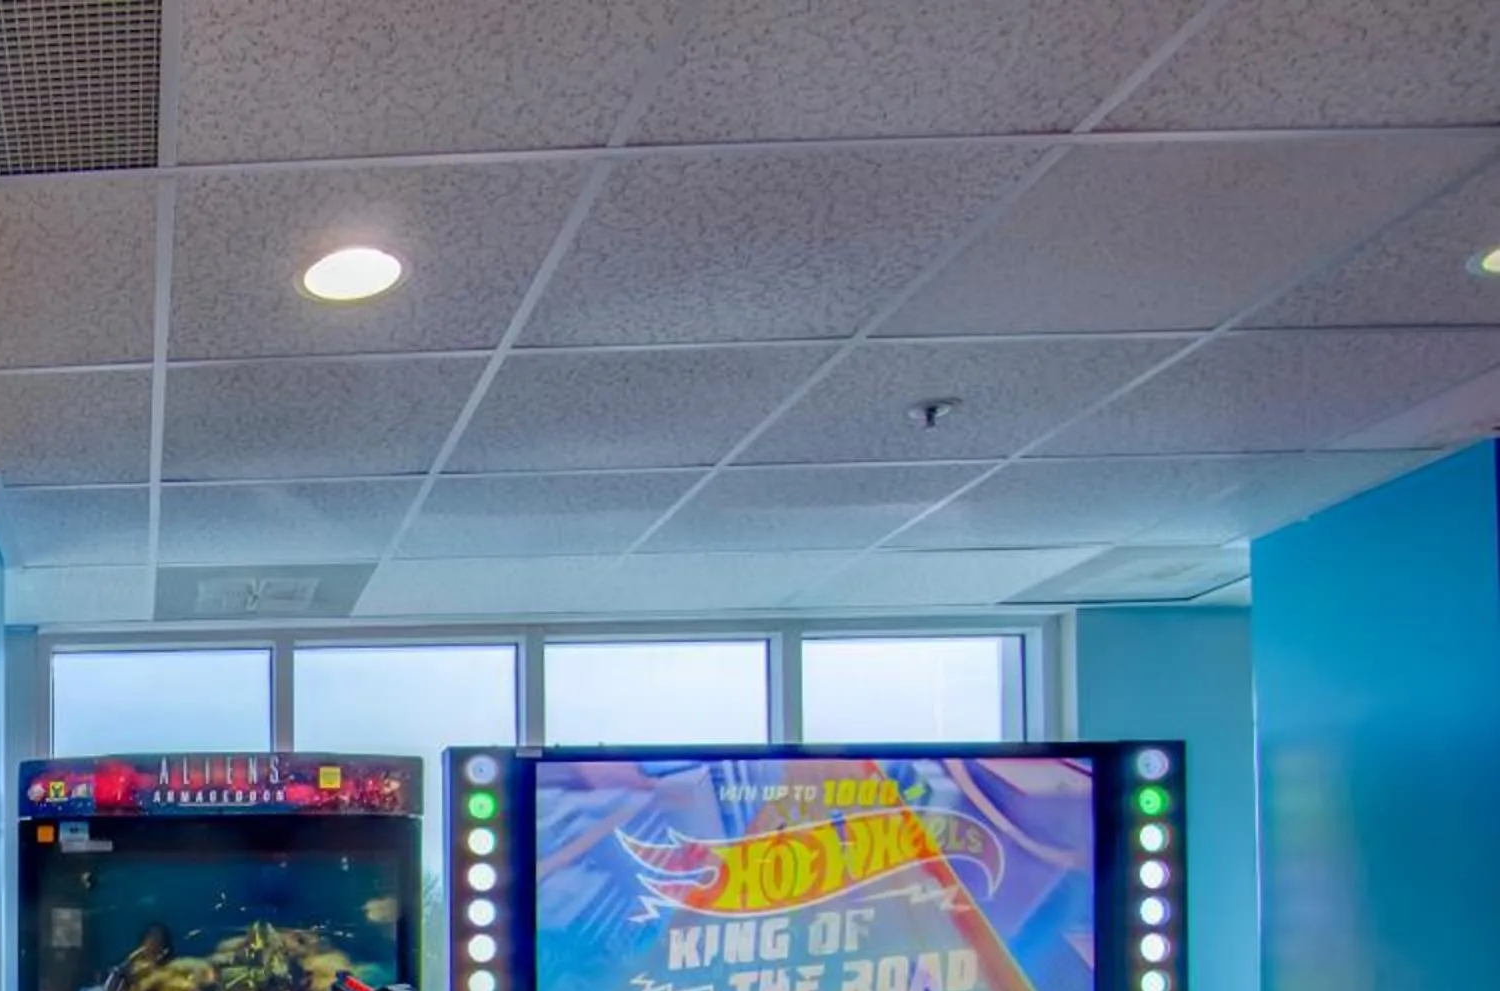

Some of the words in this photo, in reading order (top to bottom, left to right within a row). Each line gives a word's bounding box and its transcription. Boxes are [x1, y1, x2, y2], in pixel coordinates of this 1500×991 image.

[159, 756, 280, 786] ALIENS
[761, 784, 790, 801] UP
[791, 784, 818, 801] TO
[668, 917, 791, 971] KING
[807, 908, 875, 956] OF
